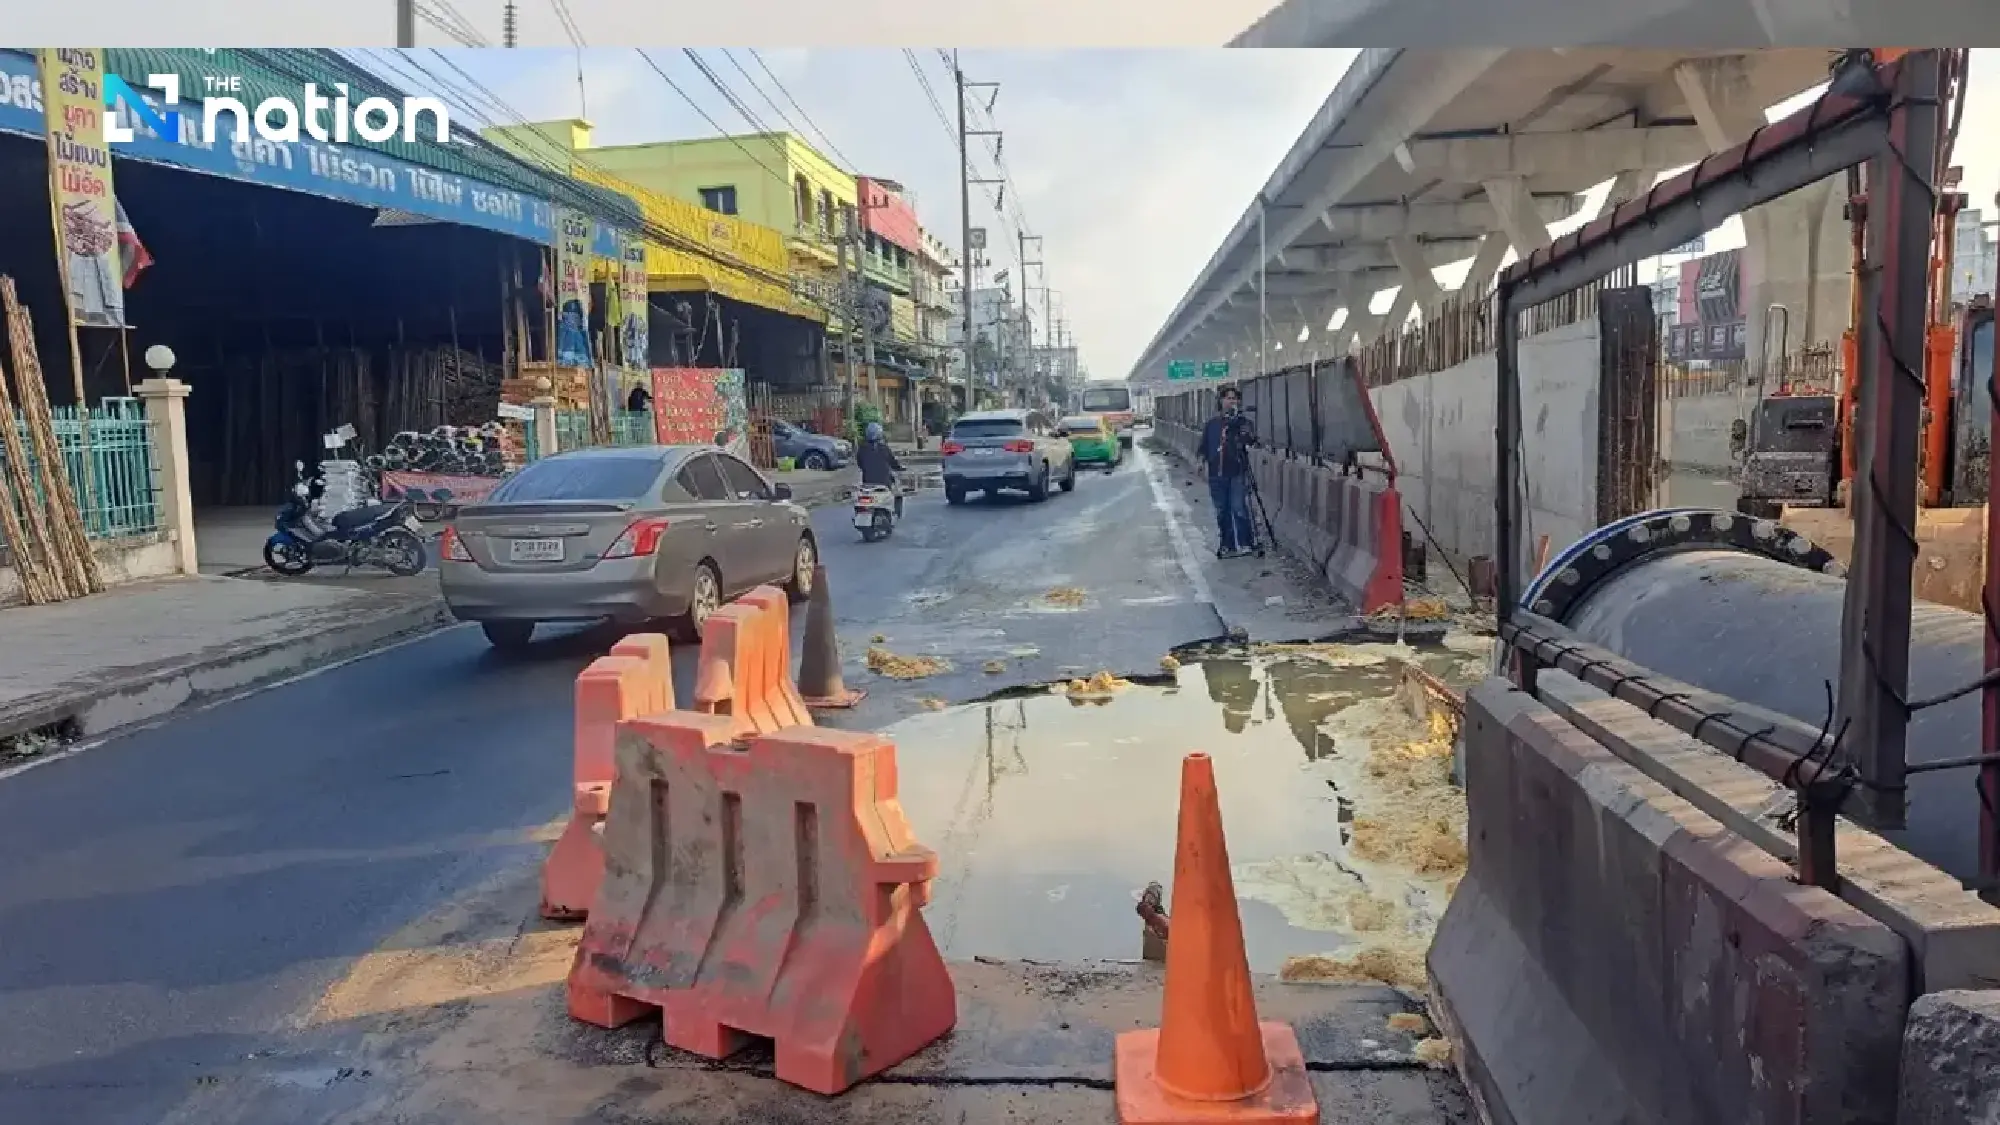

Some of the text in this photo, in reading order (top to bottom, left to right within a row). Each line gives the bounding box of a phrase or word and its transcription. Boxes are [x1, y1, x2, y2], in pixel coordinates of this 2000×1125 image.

[59, 67, 98, 101] สร้าง
[64, 104, 97, 133] ยูคา
[52, 130, 107, 168] ไม้แบบ
[59, 163, 107, 198] ไม้อัด
[301, 143, 396, 193] ไม้รวก
